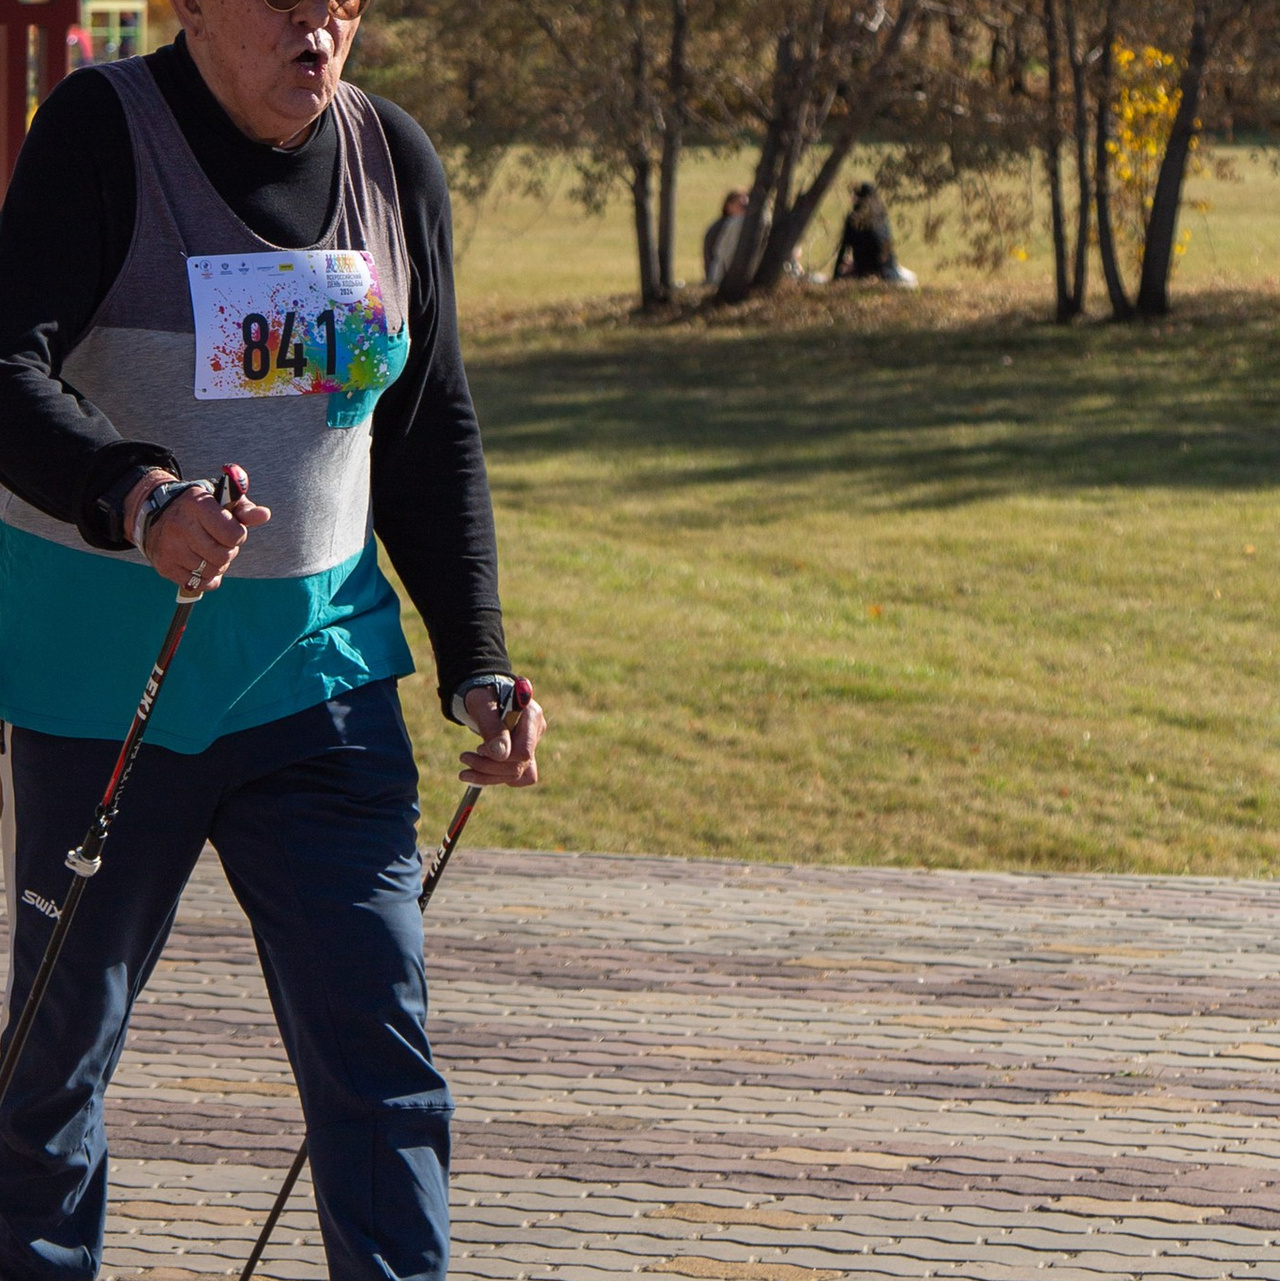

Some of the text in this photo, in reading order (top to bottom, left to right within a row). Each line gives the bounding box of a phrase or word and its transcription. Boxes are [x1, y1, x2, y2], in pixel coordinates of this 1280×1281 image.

[340, 288, 354, 296] 2024
[242, 309, 337, 380] 841
[137, 663, 164, 721] LEKI
